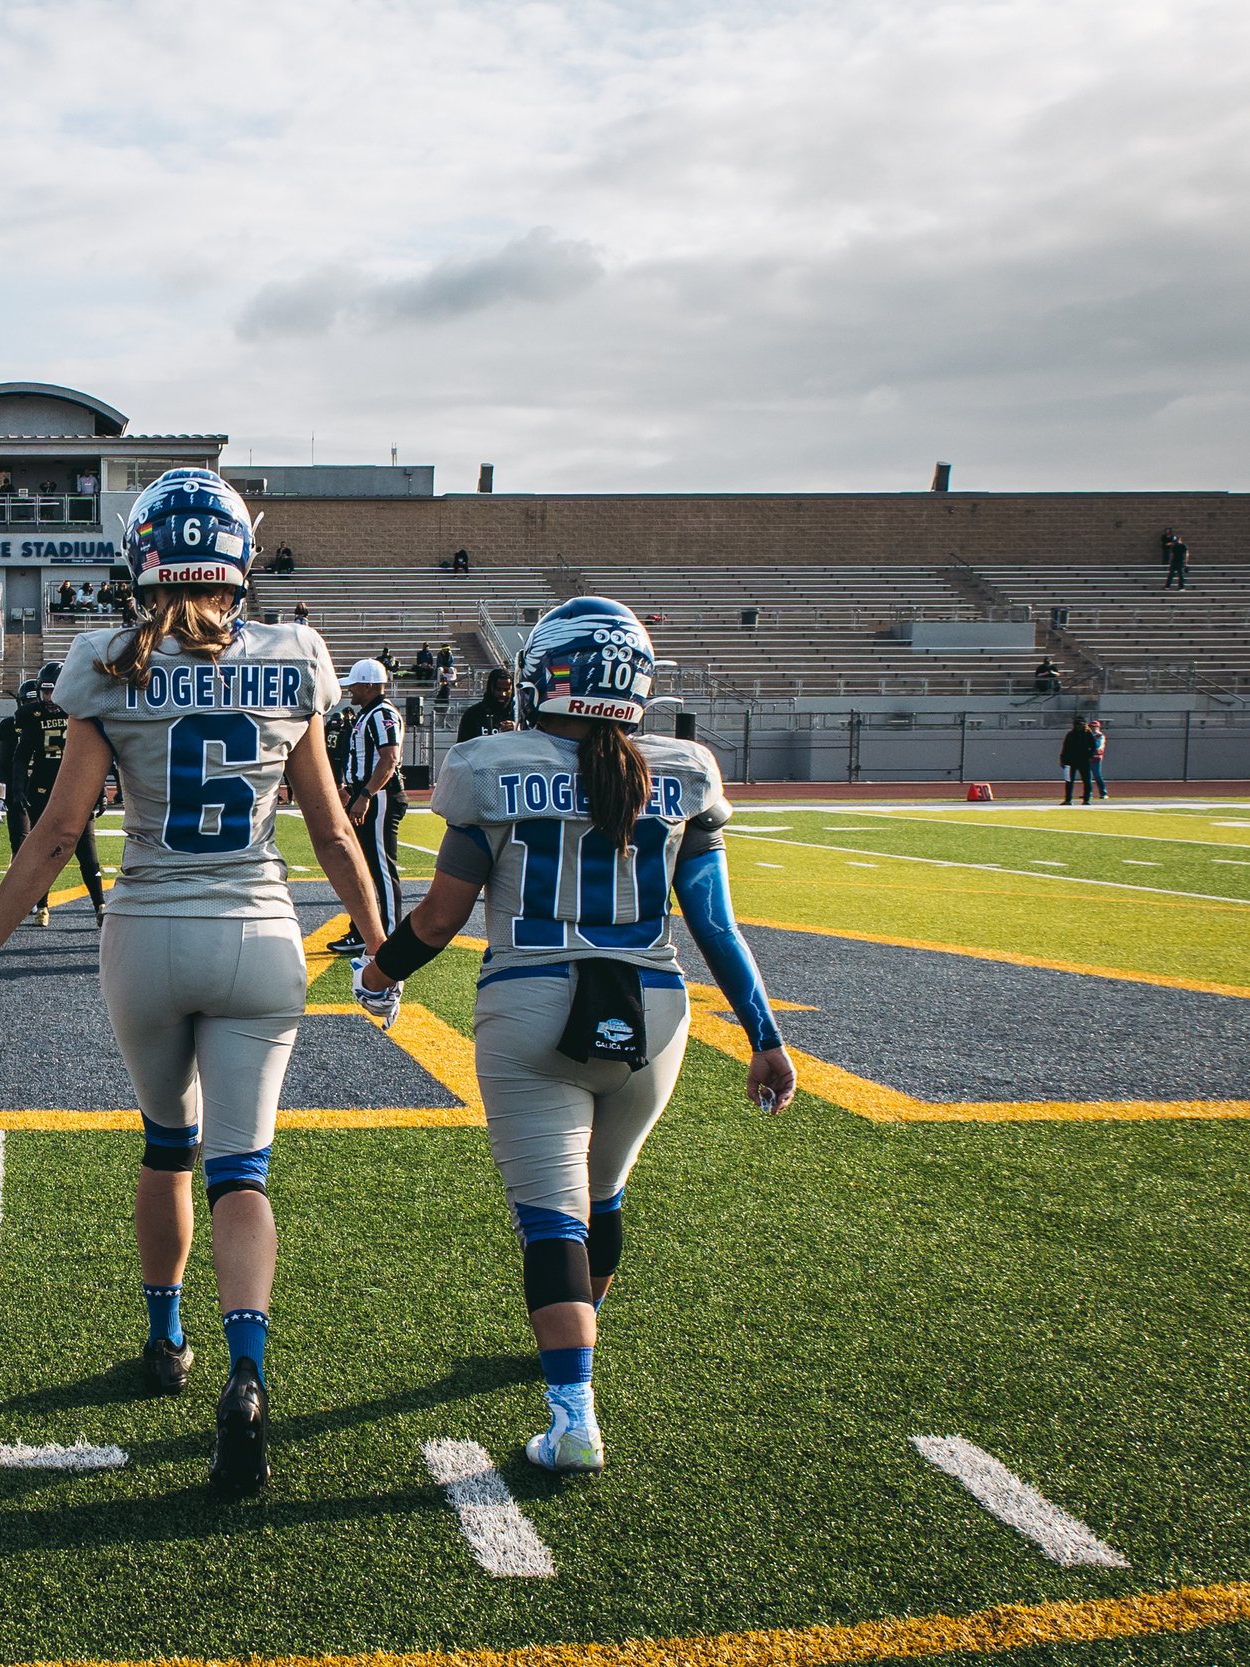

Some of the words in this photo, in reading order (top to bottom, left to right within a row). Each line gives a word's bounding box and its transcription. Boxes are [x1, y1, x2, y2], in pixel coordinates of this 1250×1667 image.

[183, 518, 201, 546] 6
[21, 541, 115, 558] STADIUM
[158, 567, 226, 583] Riddell
[598, 660, 632, 690] 10
[568, 699, 635, 720] Riddell
[40, 718, 69, 729] LEGEN
[161, 712, 261, 855] 6
[498, 772, 687, 818] TOGEER
[974, 785, 992, 799] 30
[511, 817, 671, 950] 10
